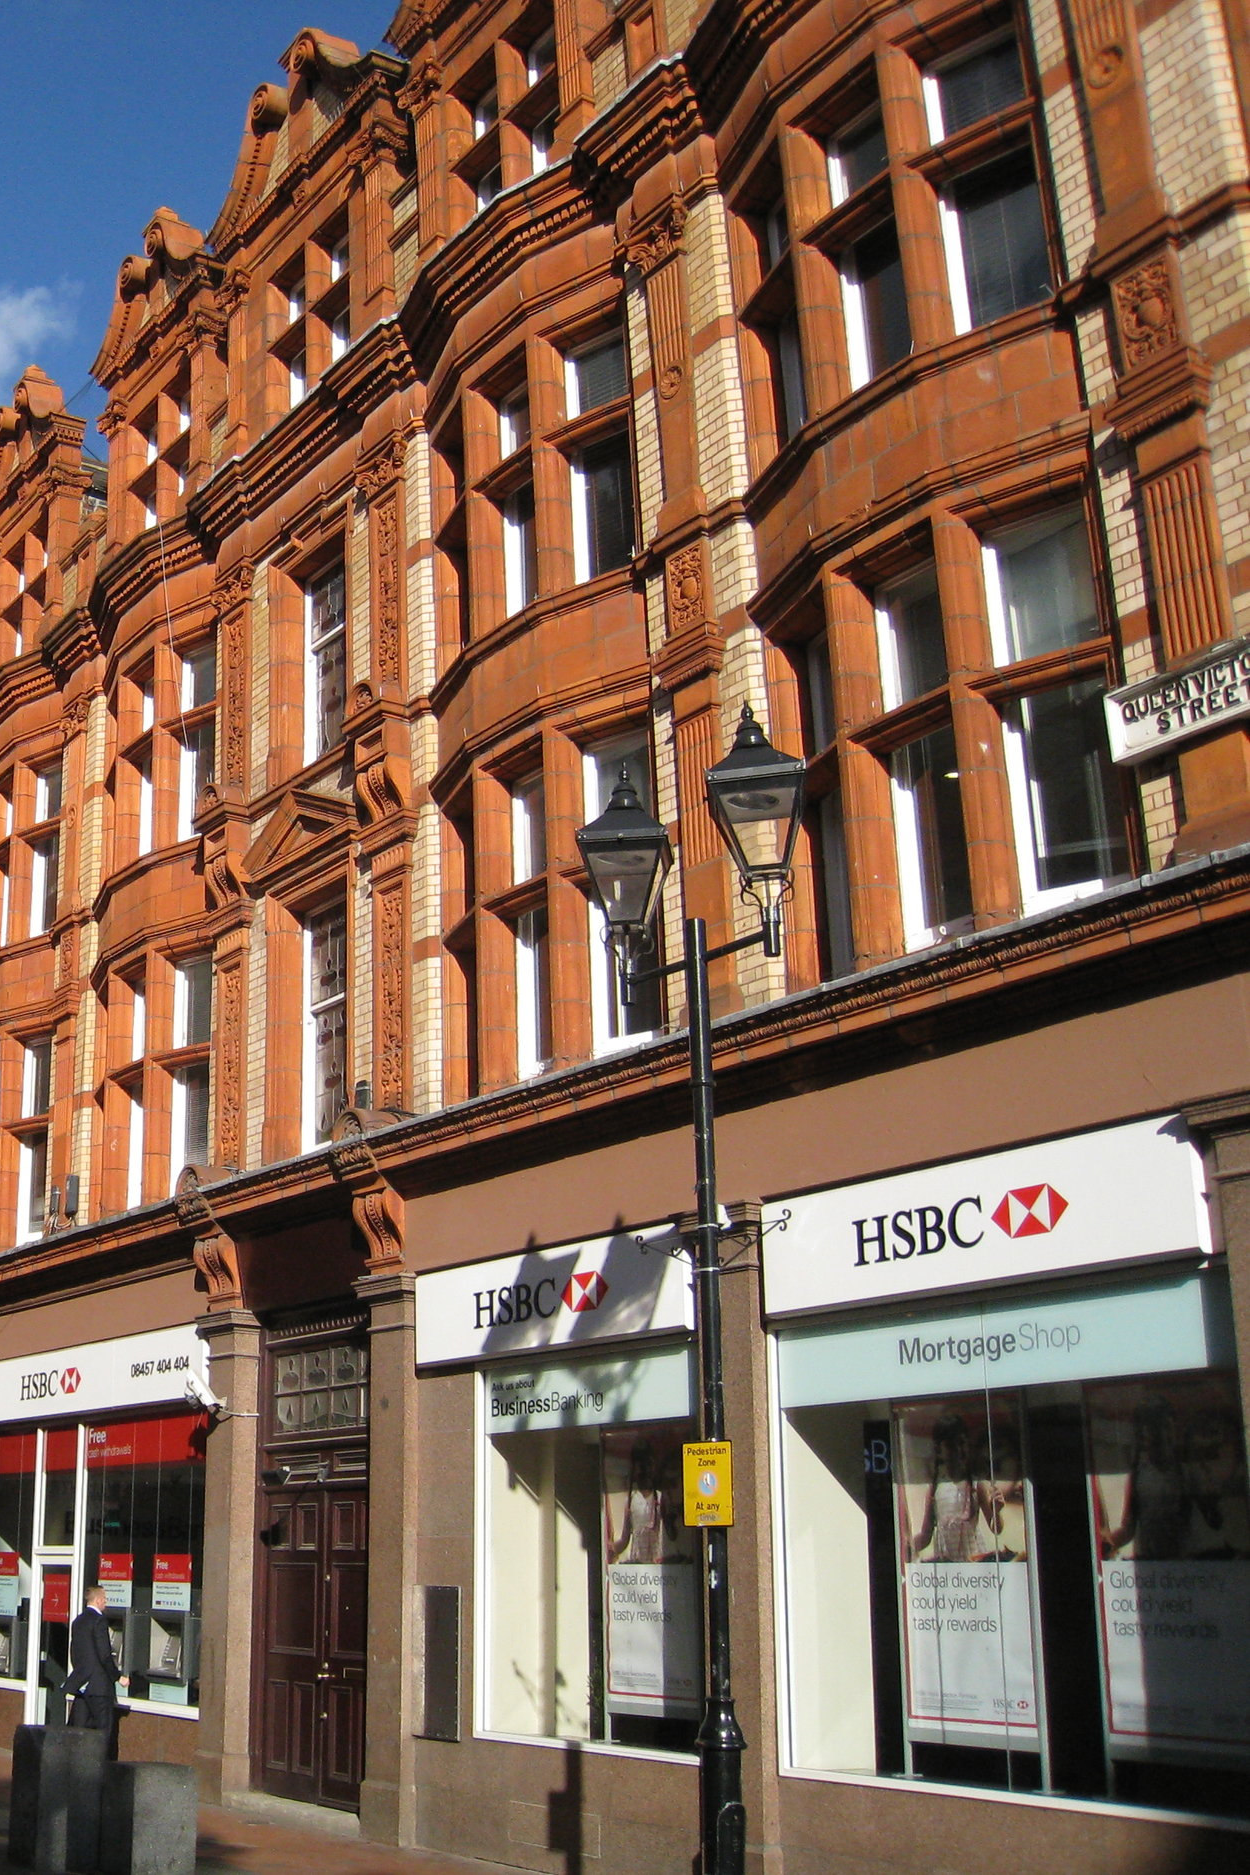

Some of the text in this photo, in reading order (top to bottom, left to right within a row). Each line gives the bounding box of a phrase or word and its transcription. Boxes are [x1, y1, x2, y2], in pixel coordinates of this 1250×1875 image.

[1121, 678, 1191, 723] QUEEN
[851, 1194, 985, 1267] HSBC
[473, 1278, 556, 1329] HSBC
[131, 1355, 189, 1378] 08457 404 404
[21, 1370, 59, 1401] HSBC
[492, 1383, 504, 1392] Ask
[516, 1379, 535, 1390] about
[88, 1428, 107, 1444] Free
[687, 1446, 727, 1456] Pedestrian
[698, 1458, 717, 1467] Zone
[696, 1502, 721, 1512] At any
[100, 1558, 113, 1568] Free
[156, 1559, 169, 1569] Free
[612, 1571, 638, 1586] Global
[911, 1571, 1005, 1591] Global diversity
[1110, 1571, 1156, 1589] Global
[612, 1590, 658, 1606] could yield
[912, 1594, 978, 1613] could yield
[613, 1609, 673, 1623] tasty rewards
[913, 1616, 998, 1635] tasty rewards
